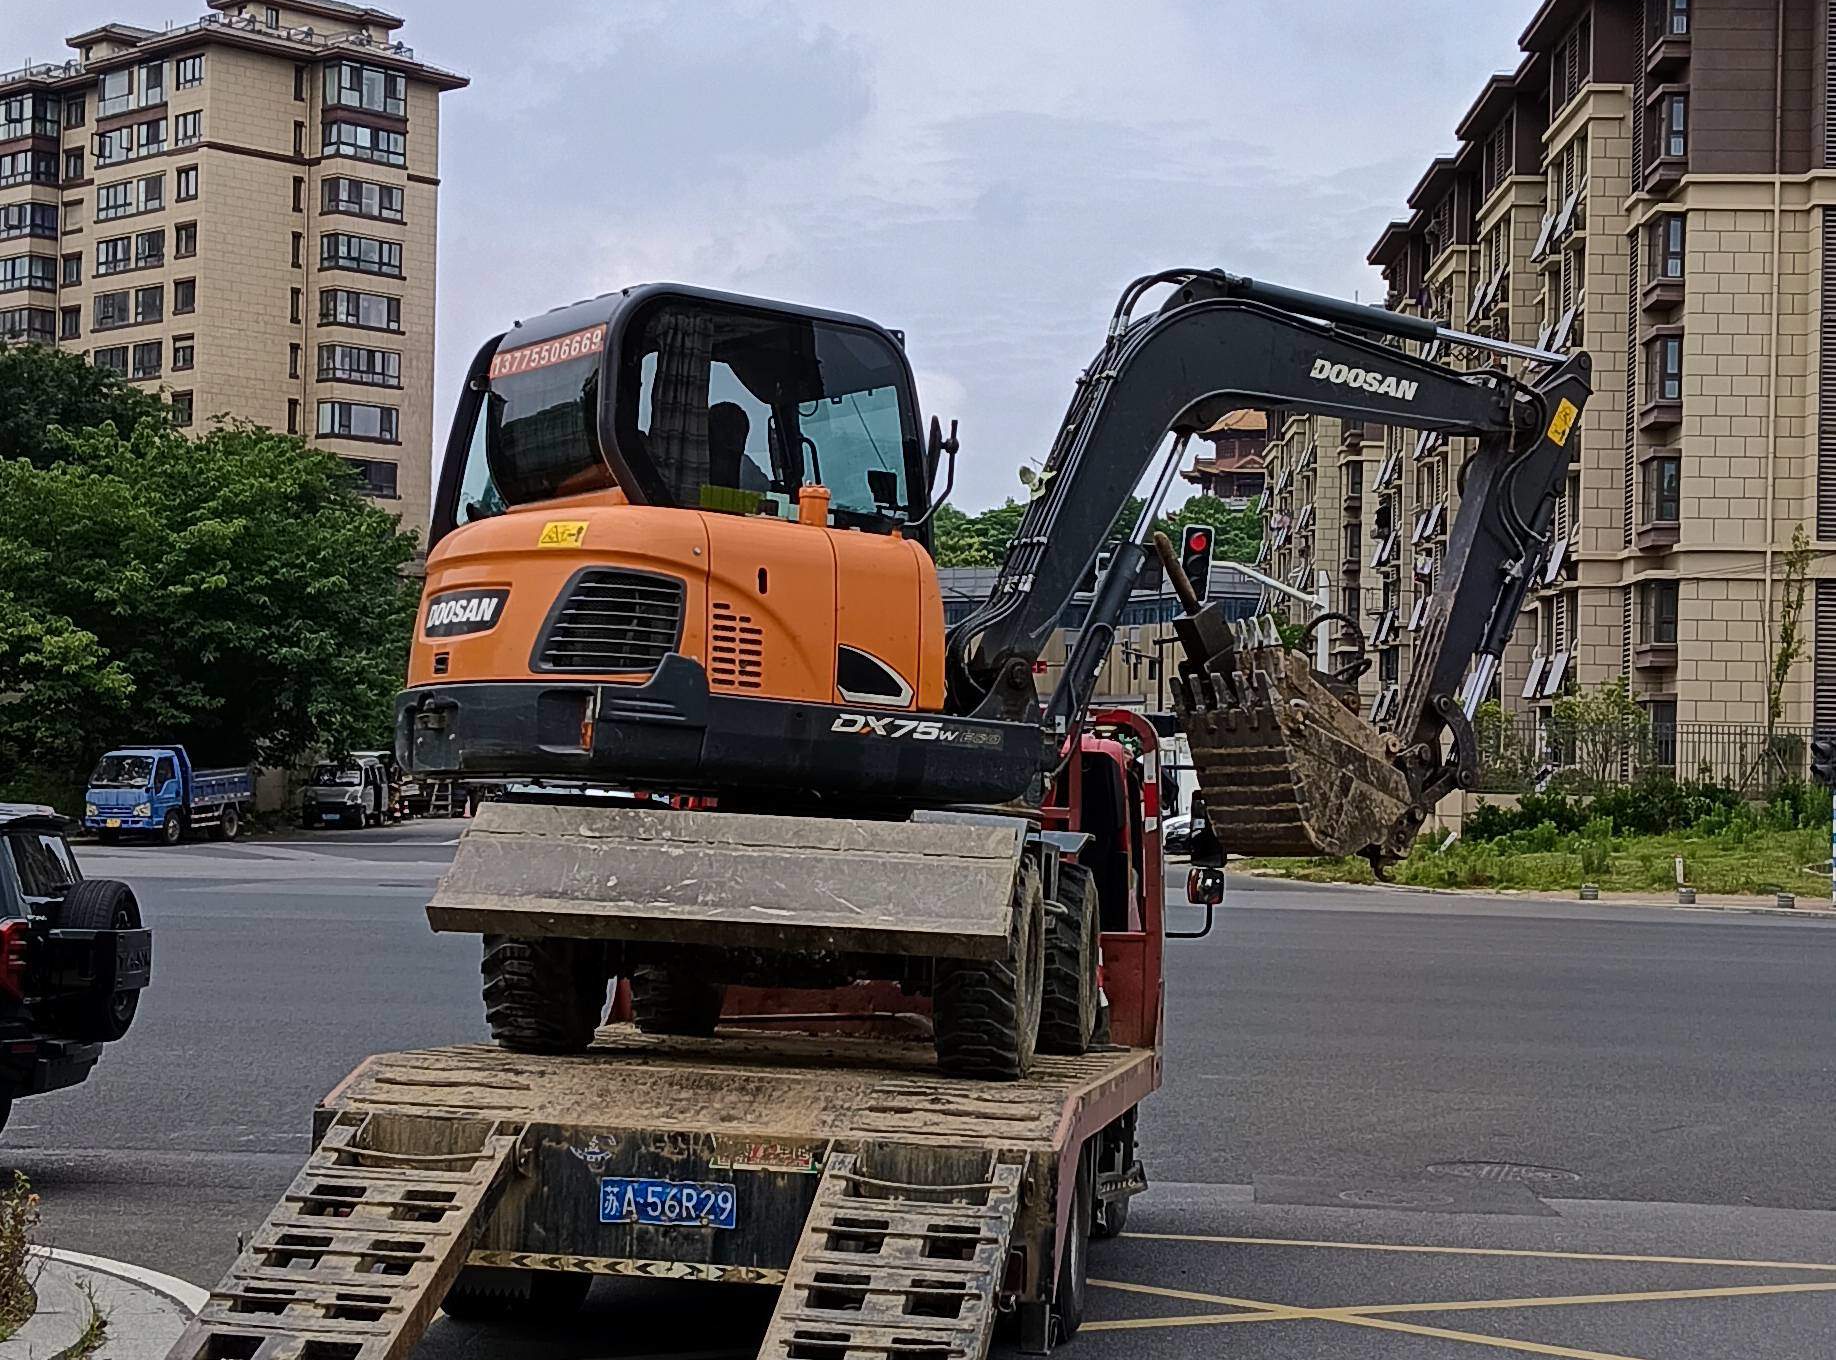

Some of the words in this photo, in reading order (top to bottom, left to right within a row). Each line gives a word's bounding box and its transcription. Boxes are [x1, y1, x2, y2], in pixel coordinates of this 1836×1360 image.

[494, 329, 602, 375] 13775506669
[1309, 358, 1419, 401] DOOSAN
[426, 597, 499, 629] DOOSAN
